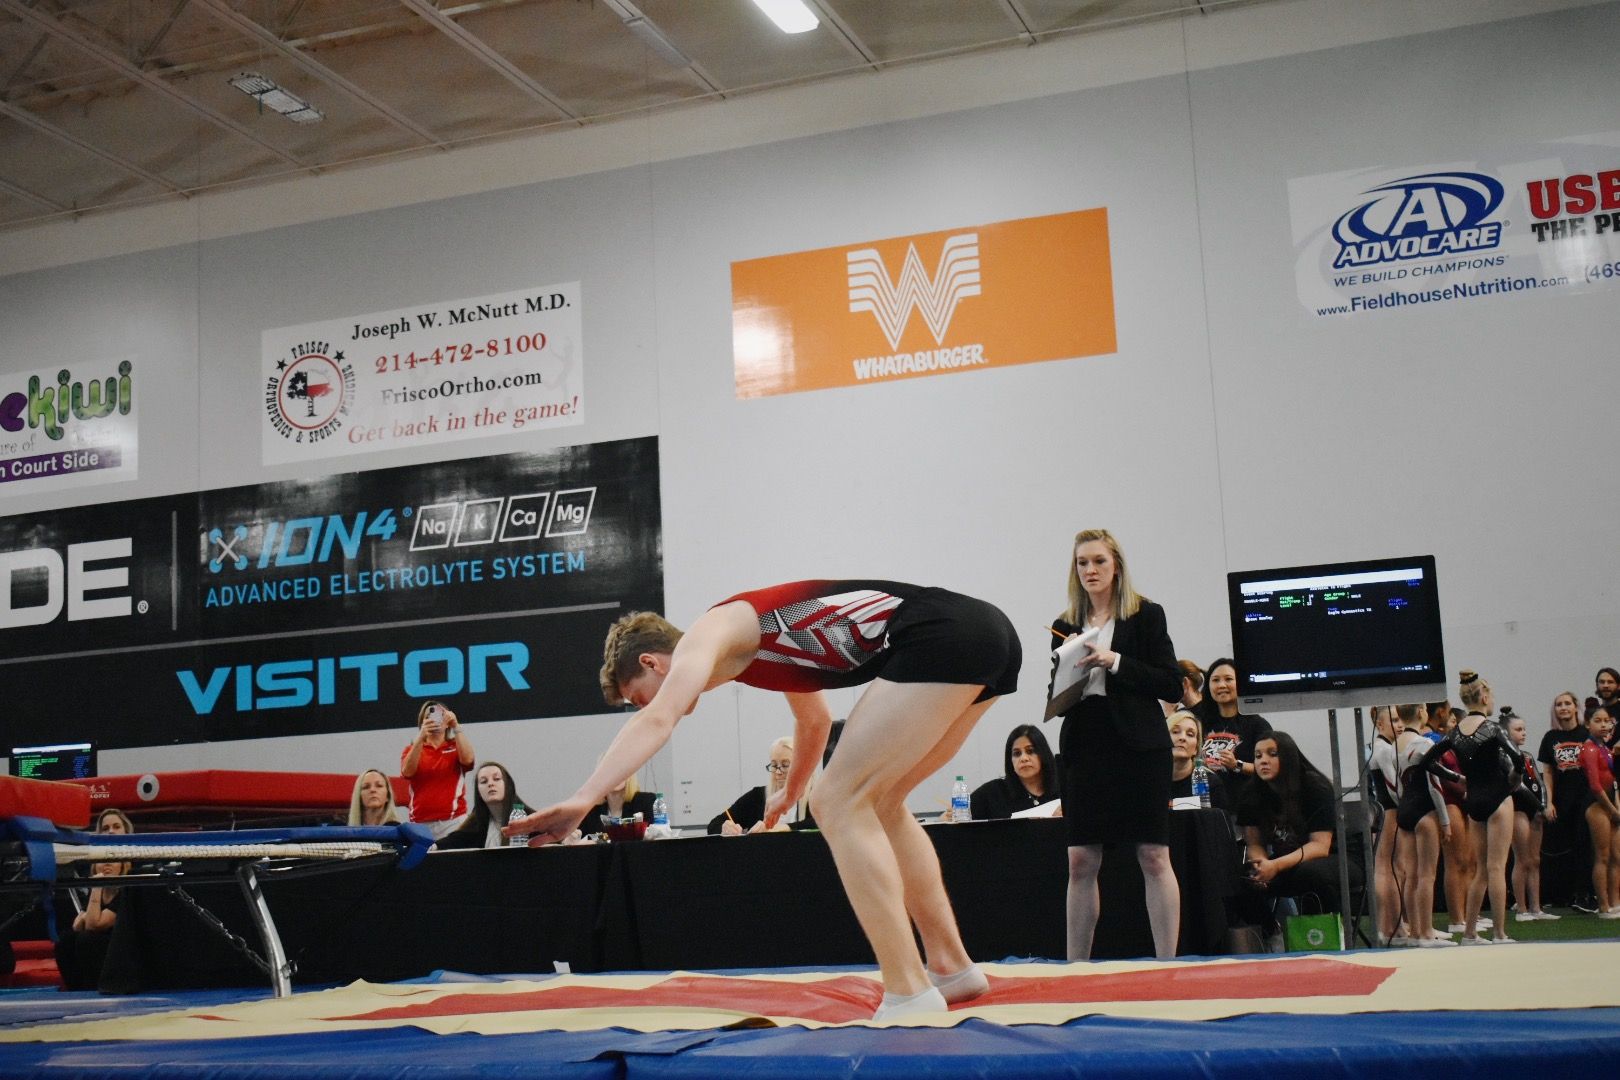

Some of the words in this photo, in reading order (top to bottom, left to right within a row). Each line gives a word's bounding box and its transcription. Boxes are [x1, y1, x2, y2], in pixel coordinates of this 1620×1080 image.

[1334, 222, 1501, 268] ADVOCARE
[1531, 217, 1586, 242] THE
[1334, 275, 1358, 287] WE
[1362, 269, 1407, 284] BUILD
[1411, 256, 1505, 276] CHAMPIONS
[1317, 274, 1569, 316] www.FieldhouseNutrition.com
[351, 317, 411, 340] Joseph
[417, 312, 442, 329] W.
[448, 302, 519, 325] McNutt
[525, 293, 571, 314] M.D.
[291, 341, 329, 359] FRISCO
[375, 332, 547, 374] 214-472-8100
[853, 343, 984, 380] WHATABURGER
[381, 372, 542, 404] FriscoOrtho.com
[265, 376, 293, 439] ORTHOPEDICS
[309, 418, 342, 443] SPORTS
[348, 424, 386, 444] Get
[392, 415, 439, 437] back
[446, 412, 466, 431] in
[474, 408, 507, 427] the
[512, 395, 579, 429] game!
[11, 455, 58, 477] Court
[62, 451, 99, 469] Side
[421, 519, 446, 536] Na
[474, 513, 485, 530] K
[510, 509, 537, 526] Ca
[557, 504, 585, 524] Mg
[206, 577, 320, 608] ADVANCED
[330, 560, 484, 596] ELECTROLYTE
[492, 551, 586, 580] SYSTEM
[176, 641, 531, 715] VISITOR
